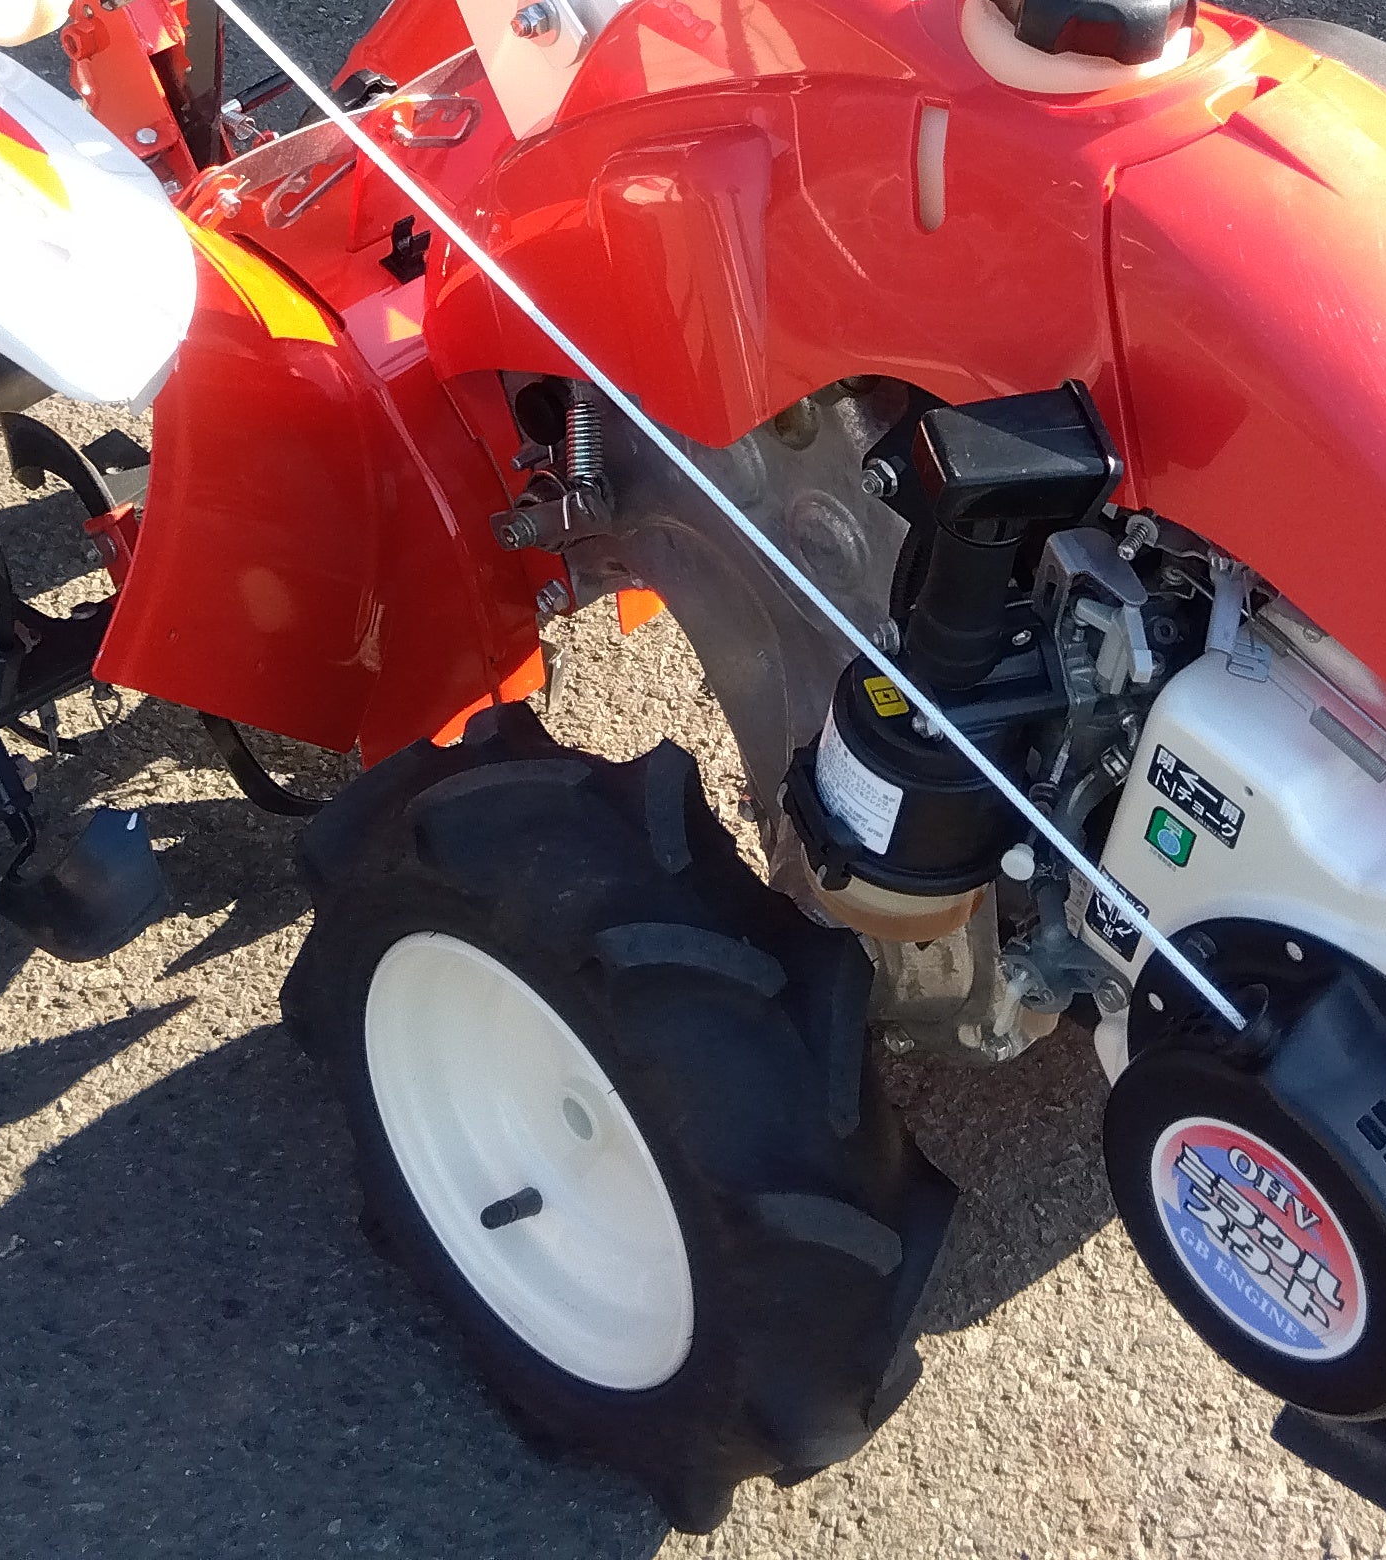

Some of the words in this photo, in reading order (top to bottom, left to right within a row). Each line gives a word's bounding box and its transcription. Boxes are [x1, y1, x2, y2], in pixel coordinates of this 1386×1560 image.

[1176, 786, 1237, 837] チョーク
[1174, 1140, 1344, 1311] ミラクル
[1228, 1146, 1322, 1230] OHV
[1180, 1225, 1210, 1260] GB
[1215, 1256, 1301, 1341] ENGINE
[1183, 1183, 1330, 1328] スタート
